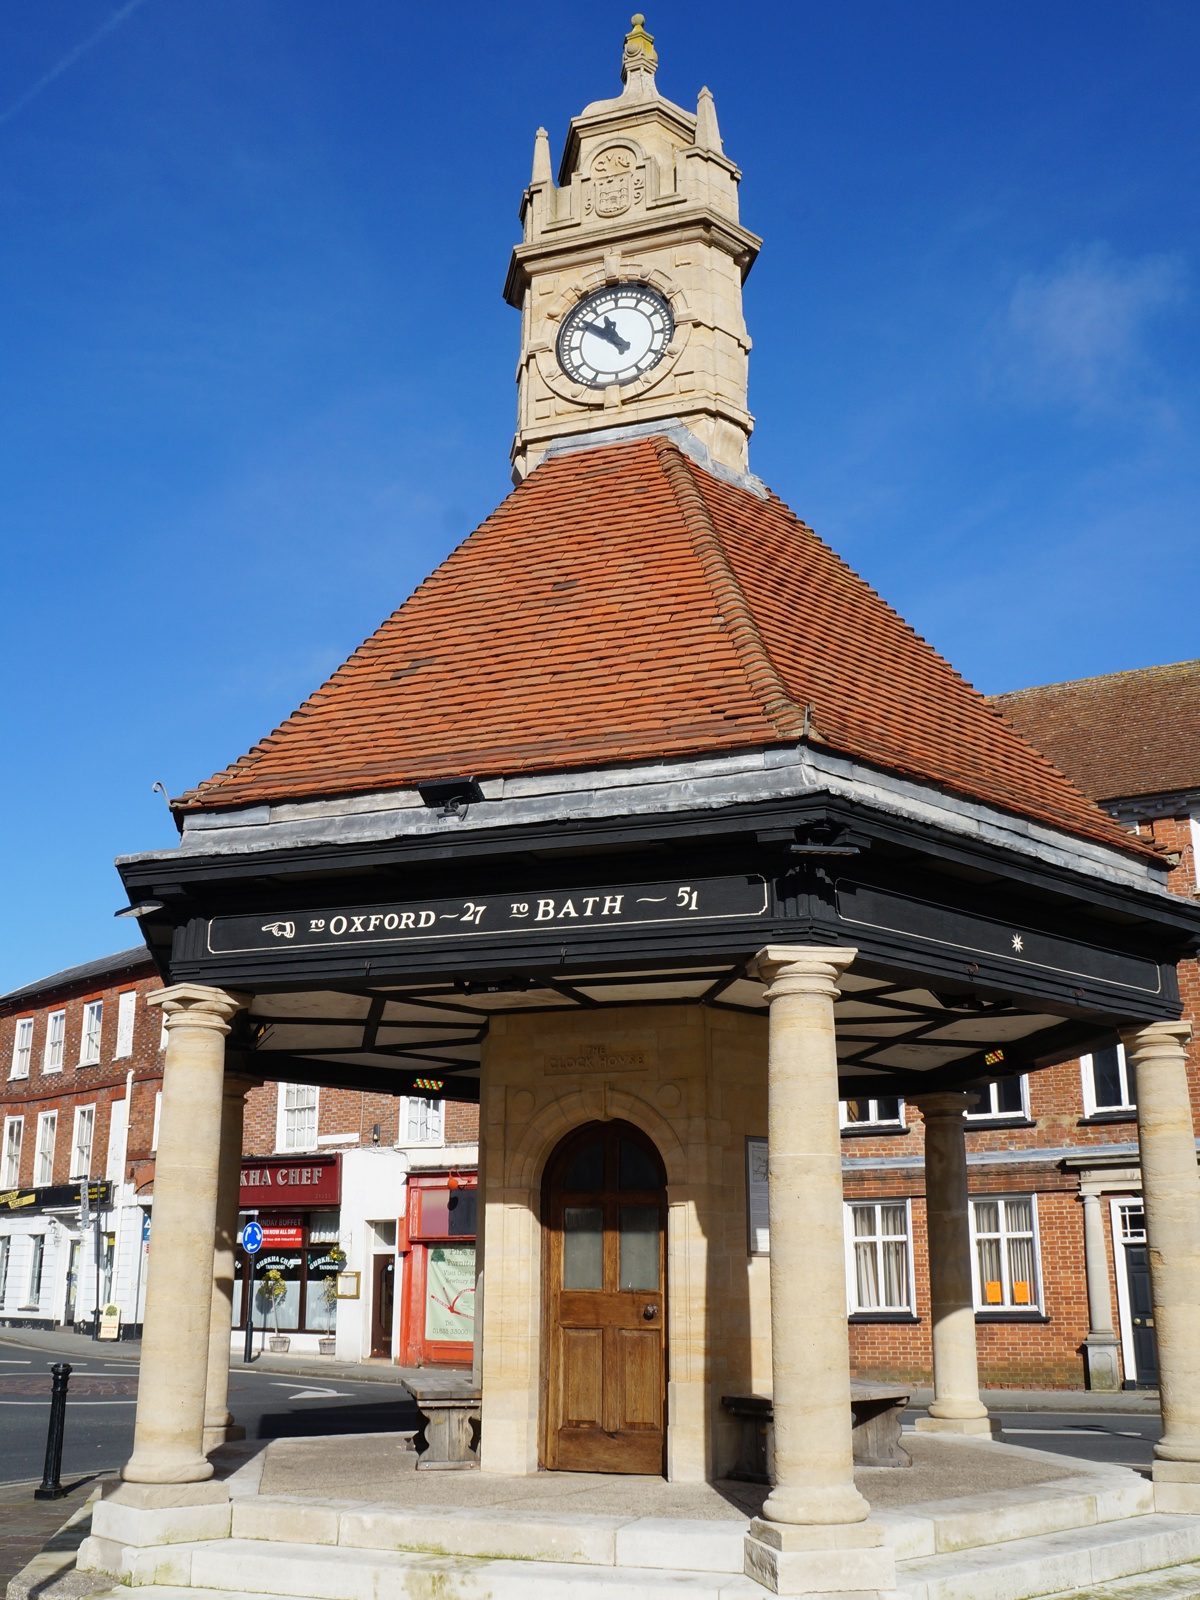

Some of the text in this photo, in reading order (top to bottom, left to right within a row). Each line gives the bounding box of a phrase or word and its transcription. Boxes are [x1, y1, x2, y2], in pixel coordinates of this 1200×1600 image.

[310, 886, 700, 935] TO OXFORD 27 TO BATH 51
[549, 1056, 595, 1070] CLOCK
[276, 1167, 323, 1186] CHEF
